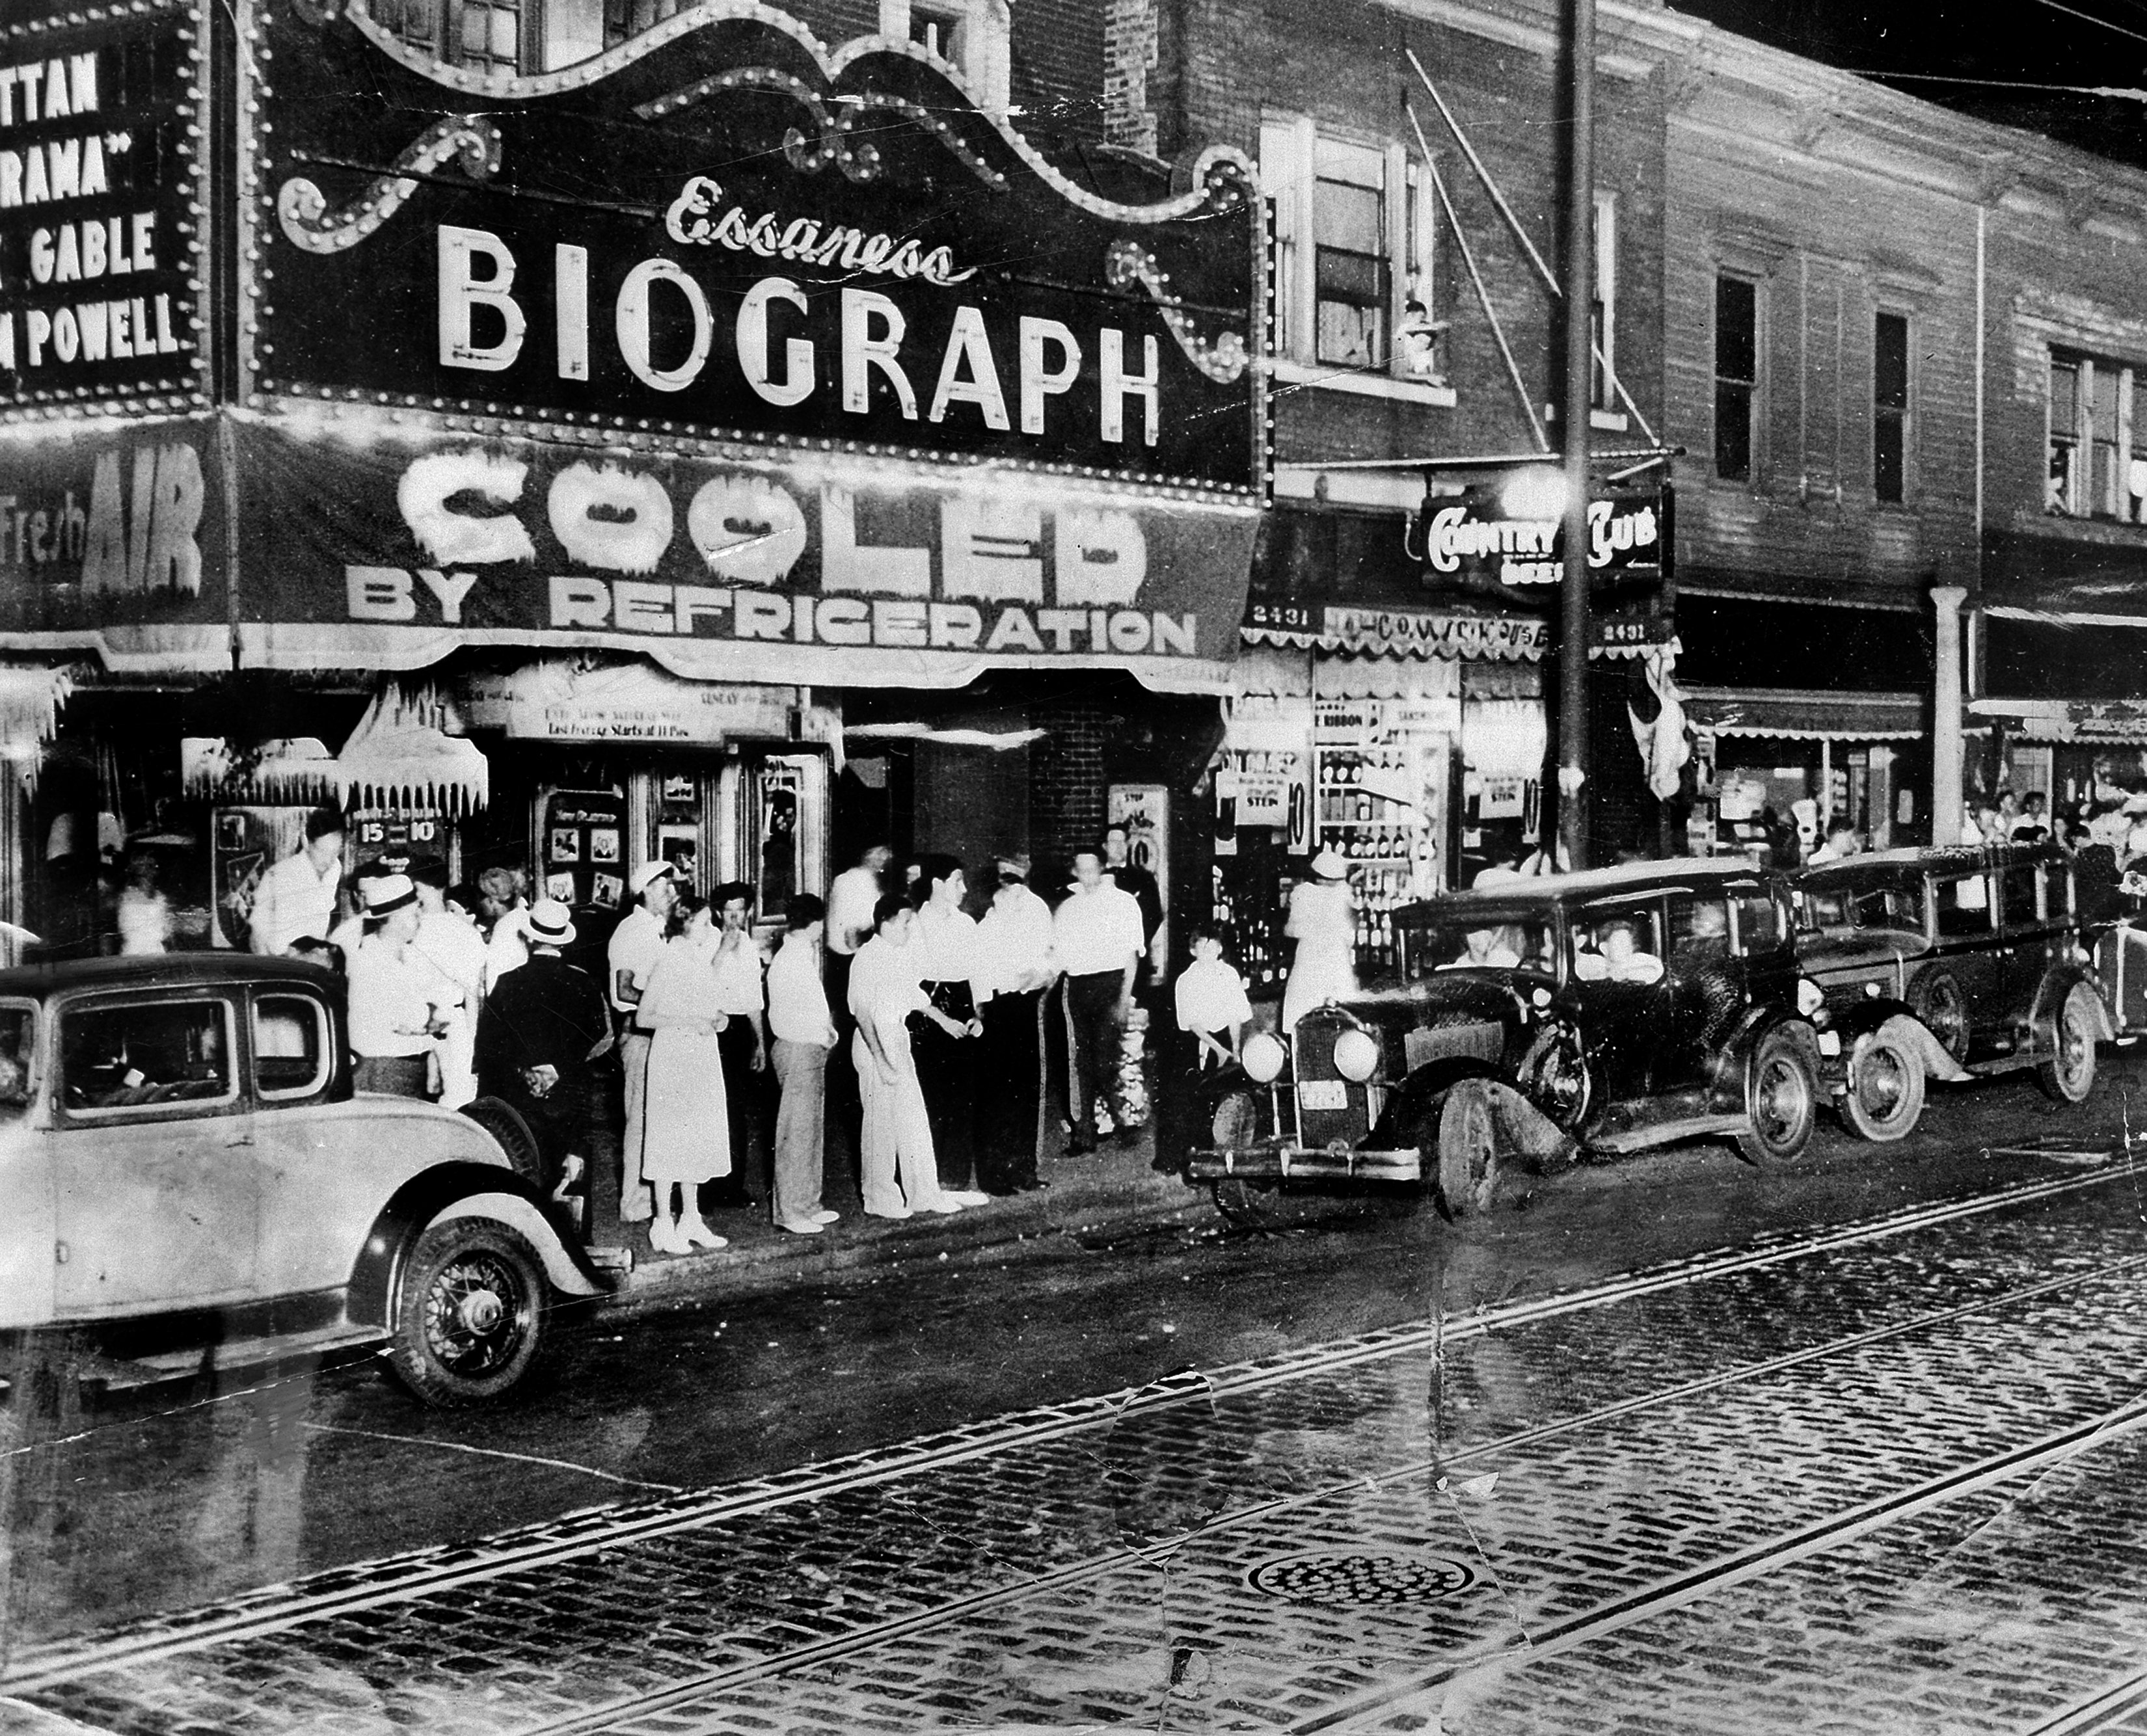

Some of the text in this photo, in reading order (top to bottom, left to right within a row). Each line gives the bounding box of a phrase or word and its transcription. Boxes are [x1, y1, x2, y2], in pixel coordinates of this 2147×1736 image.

[31, 211, 156, 284] GABLE
[667, 176, 977, 285] Essaness
[27, 293, 177, 367] POWELL
[438, 224, 1159, 446] BIOGRAPH
[81, 442, 204, 597] AIR
[397, 450, 1146, 608] COOLED
[345, 565, 1196, 654] BY REFRIGERATION
[1254, 605, 1308, 626] 2431
[1604, 624, 1644, 640] 2431
[362, 821, 435, 842] 15 10
